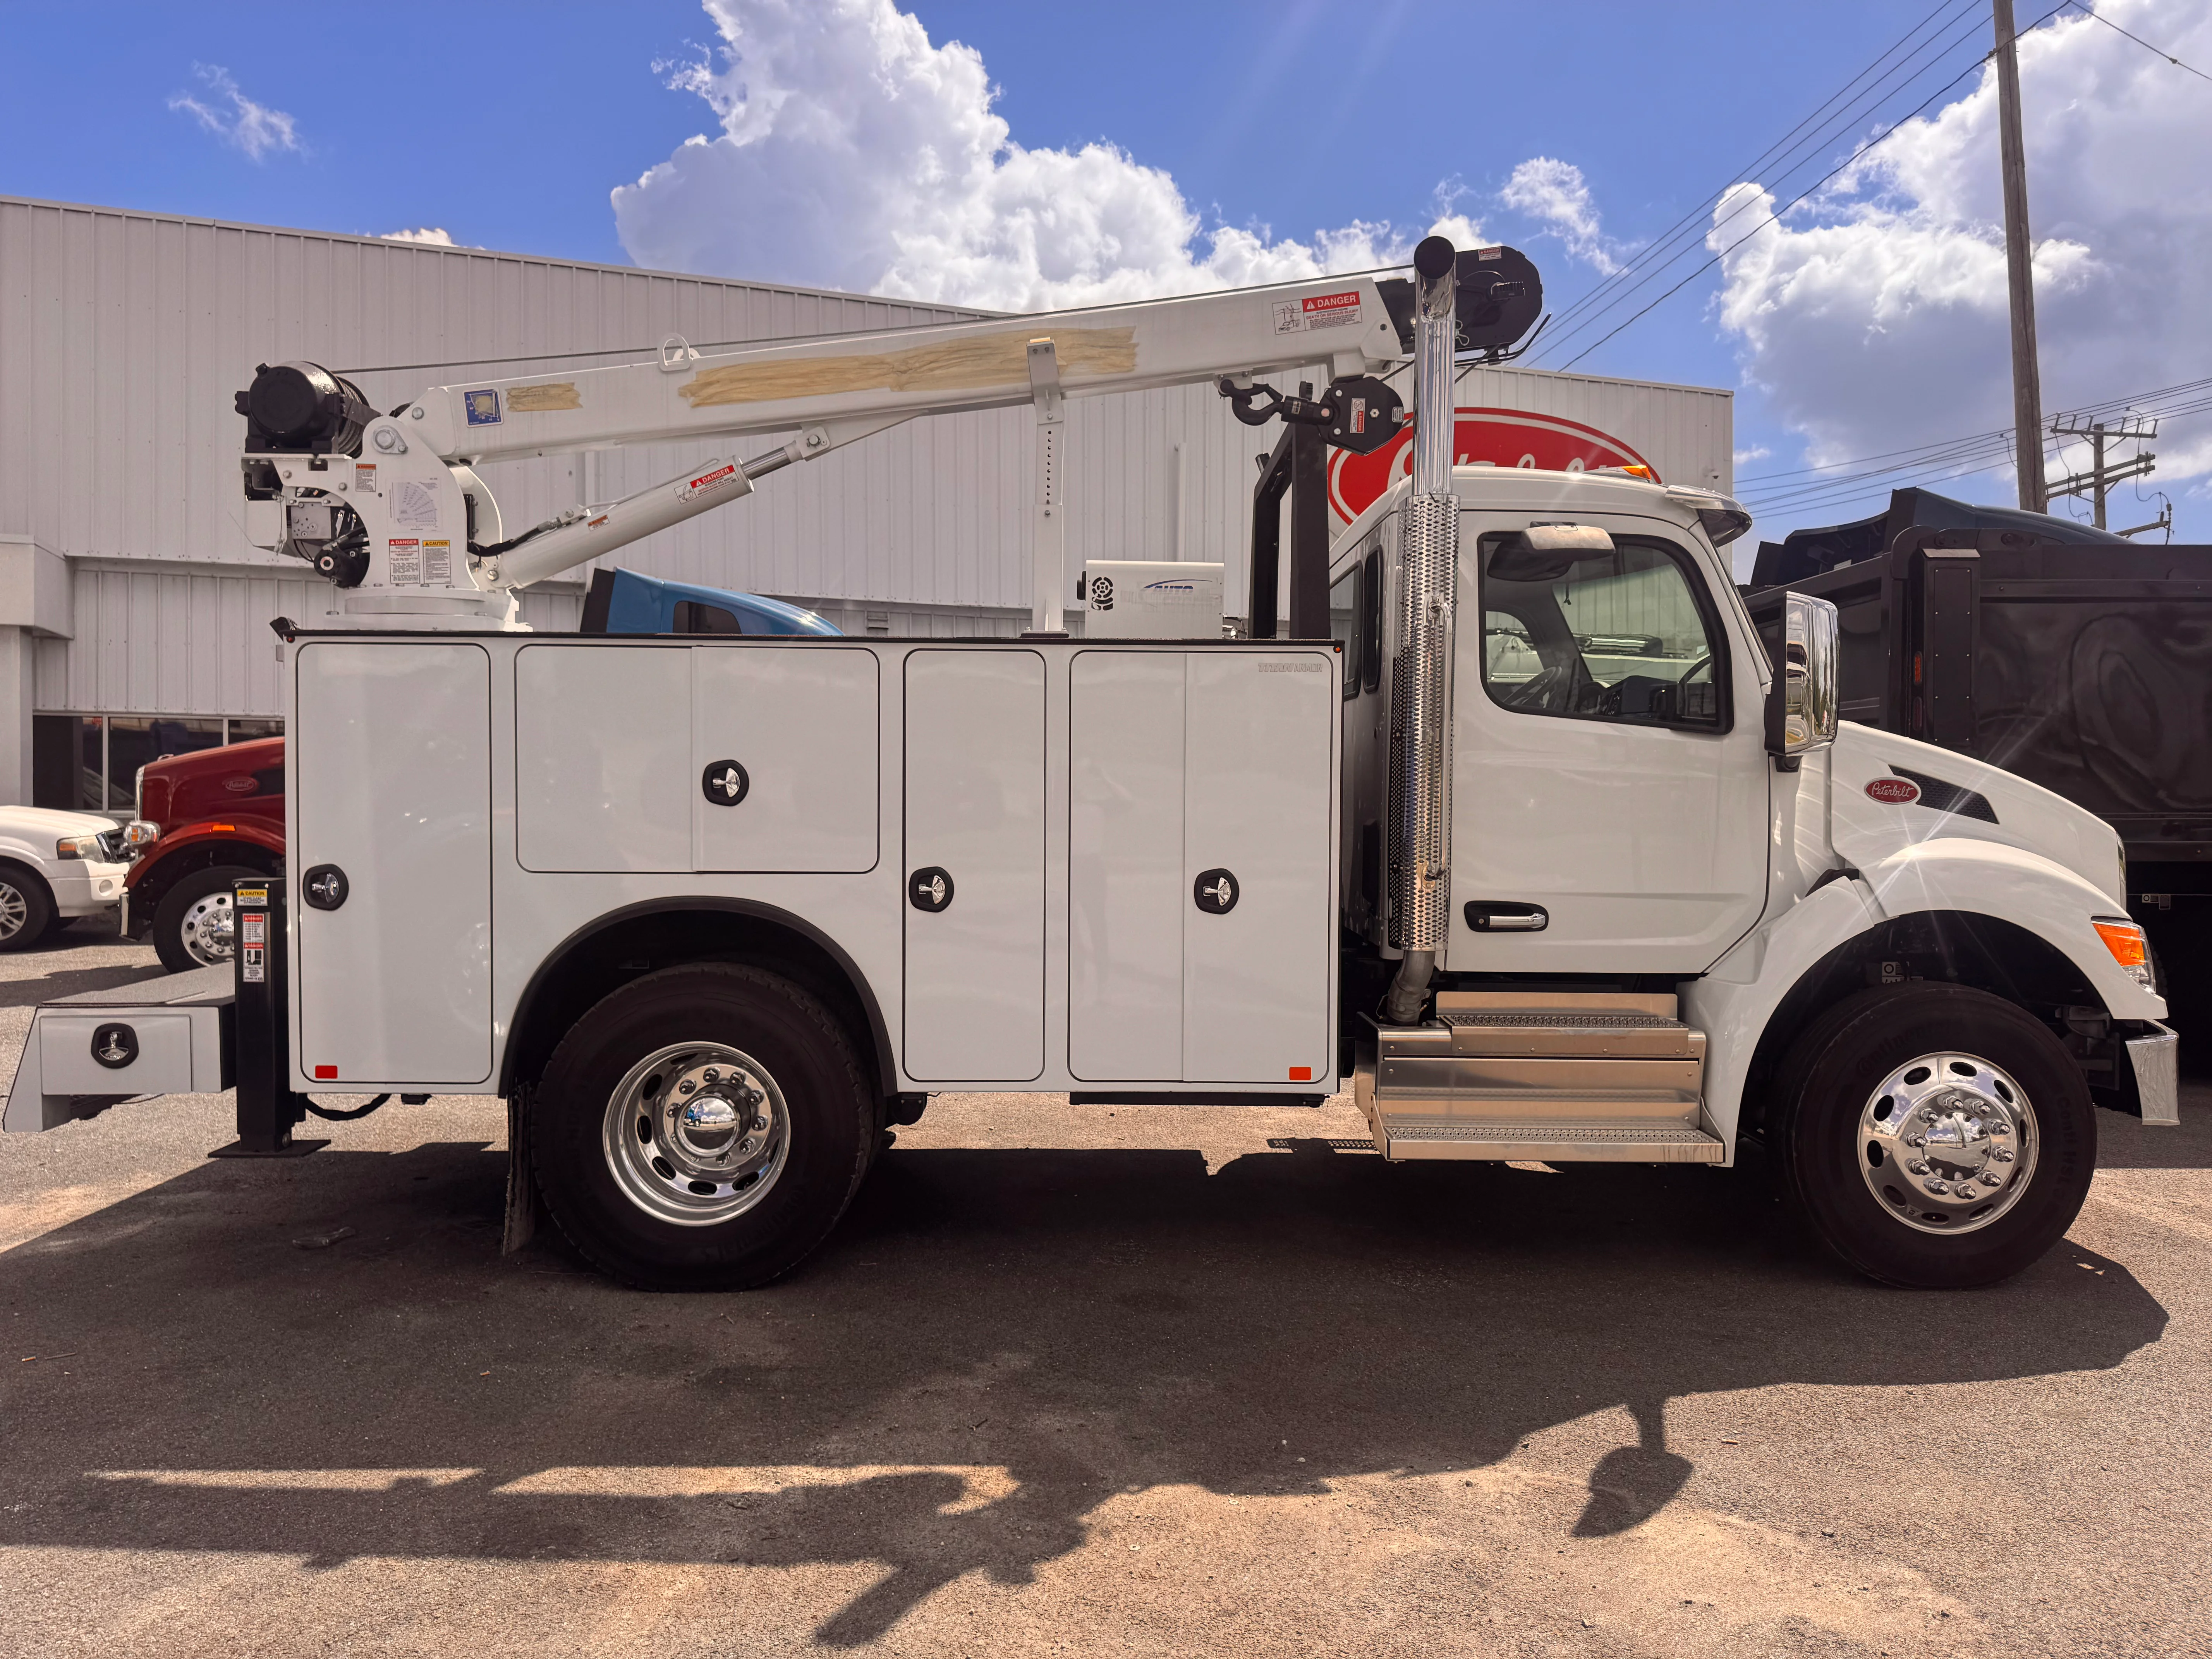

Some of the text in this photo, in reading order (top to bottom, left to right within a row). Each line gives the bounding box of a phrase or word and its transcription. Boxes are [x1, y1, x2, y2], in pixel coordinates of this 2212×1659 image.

[1317, 295, 1356, 307] DANGER
[702, 468, 730, 483] DANGER
[1872, 782, 1914, 797] Peterbilt
